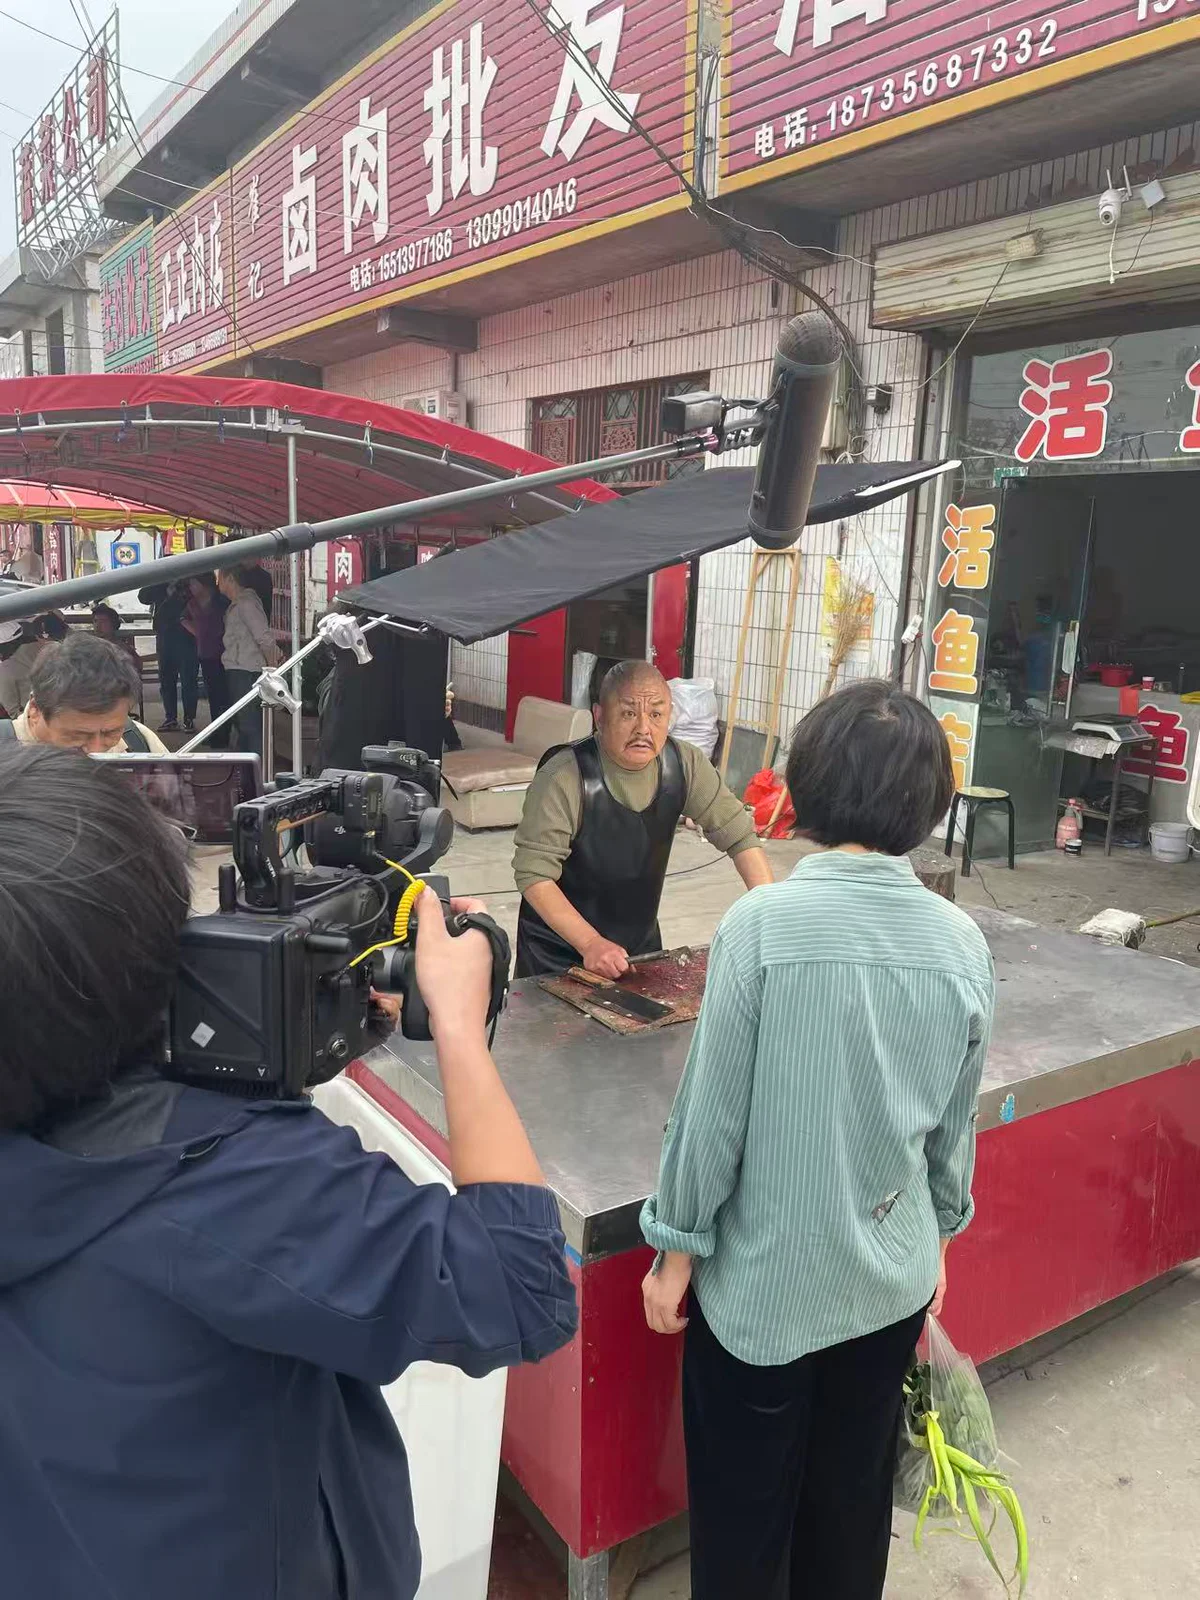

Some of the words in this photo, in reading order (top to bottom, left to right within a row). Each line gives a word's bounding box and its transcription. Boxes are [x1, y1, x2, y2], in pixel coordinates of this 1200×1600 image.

[282, 0, 641, 286] 卤肉批发
[466, 177, 578, 249] 13099014046
[334, 546, 353, 596] 肉
